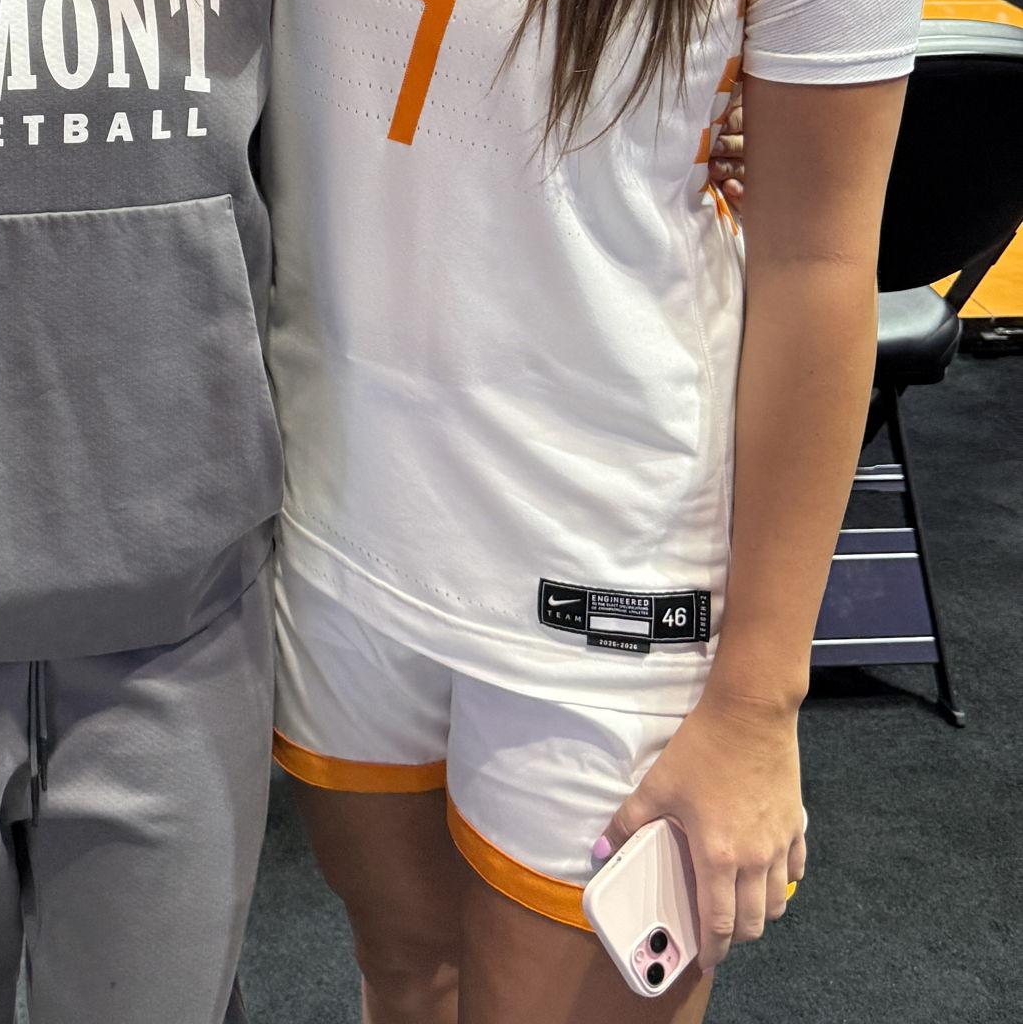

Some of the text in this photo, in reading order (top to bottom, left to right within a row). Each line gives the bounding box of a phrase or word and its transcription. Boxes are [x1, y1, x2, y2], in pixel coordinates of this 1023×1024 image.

[591, 594, 649, 606] ENGINEERED
[547, 609, 582, 623] TEAM
[662, 607, 687, 627] 46
[599, 639, 638, 650] 2025-2026
